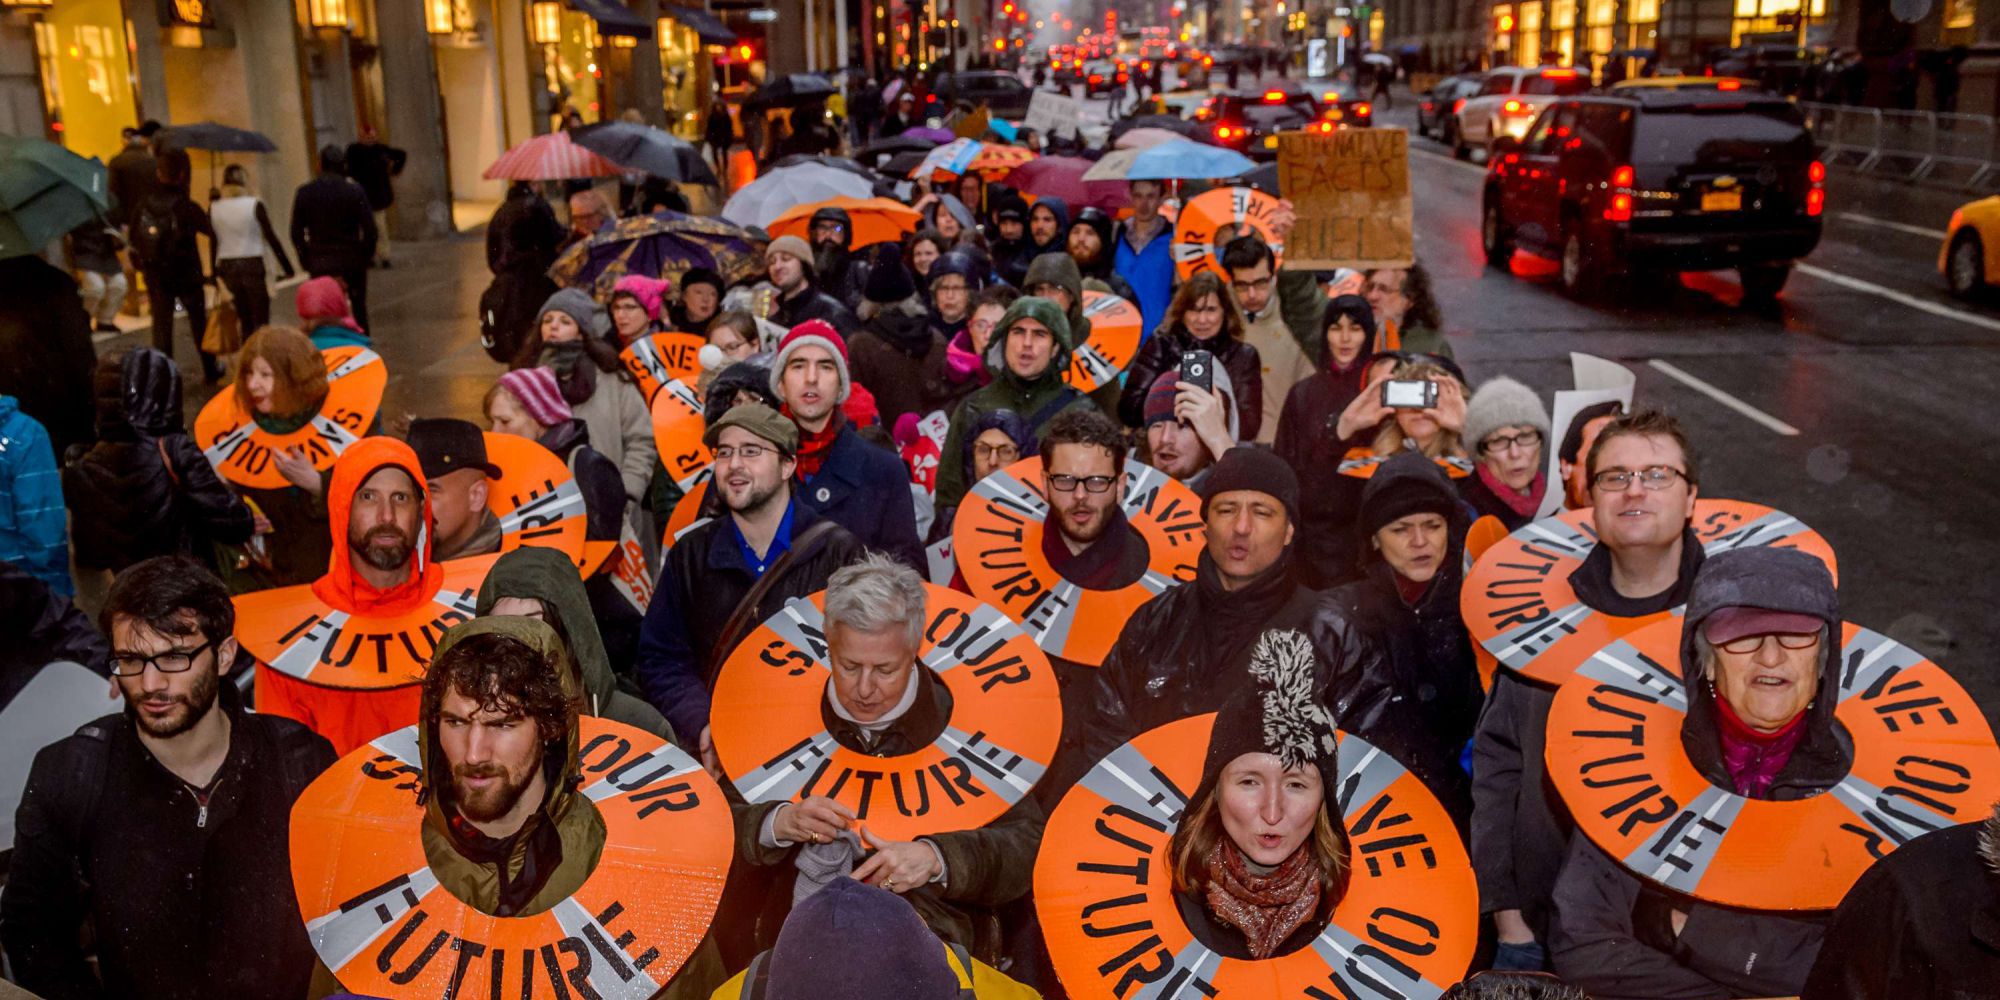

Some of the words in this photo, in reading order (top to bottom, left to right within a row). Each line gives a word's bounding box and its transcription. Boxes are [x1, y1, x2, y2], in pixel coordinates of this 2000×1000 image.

[1286, 159, 1393, 196] FACTS
[629, 344, 697, 380] SAVE
[212, 422, 272, 475] OUR
[976, 477, 1069, 632] FUTURE
[1485, 521, 1600, 656] FUTURE
[759, 622, 829, 676] SA
[925, 607, 1031, 693] OUR
[578, 733, 701, 820] OUR
[763, 731, 1024, 820] FUTURE
[1571, 652, 1727, 873] FUTURE
[339, 873, 661, 1000] FUTURE
